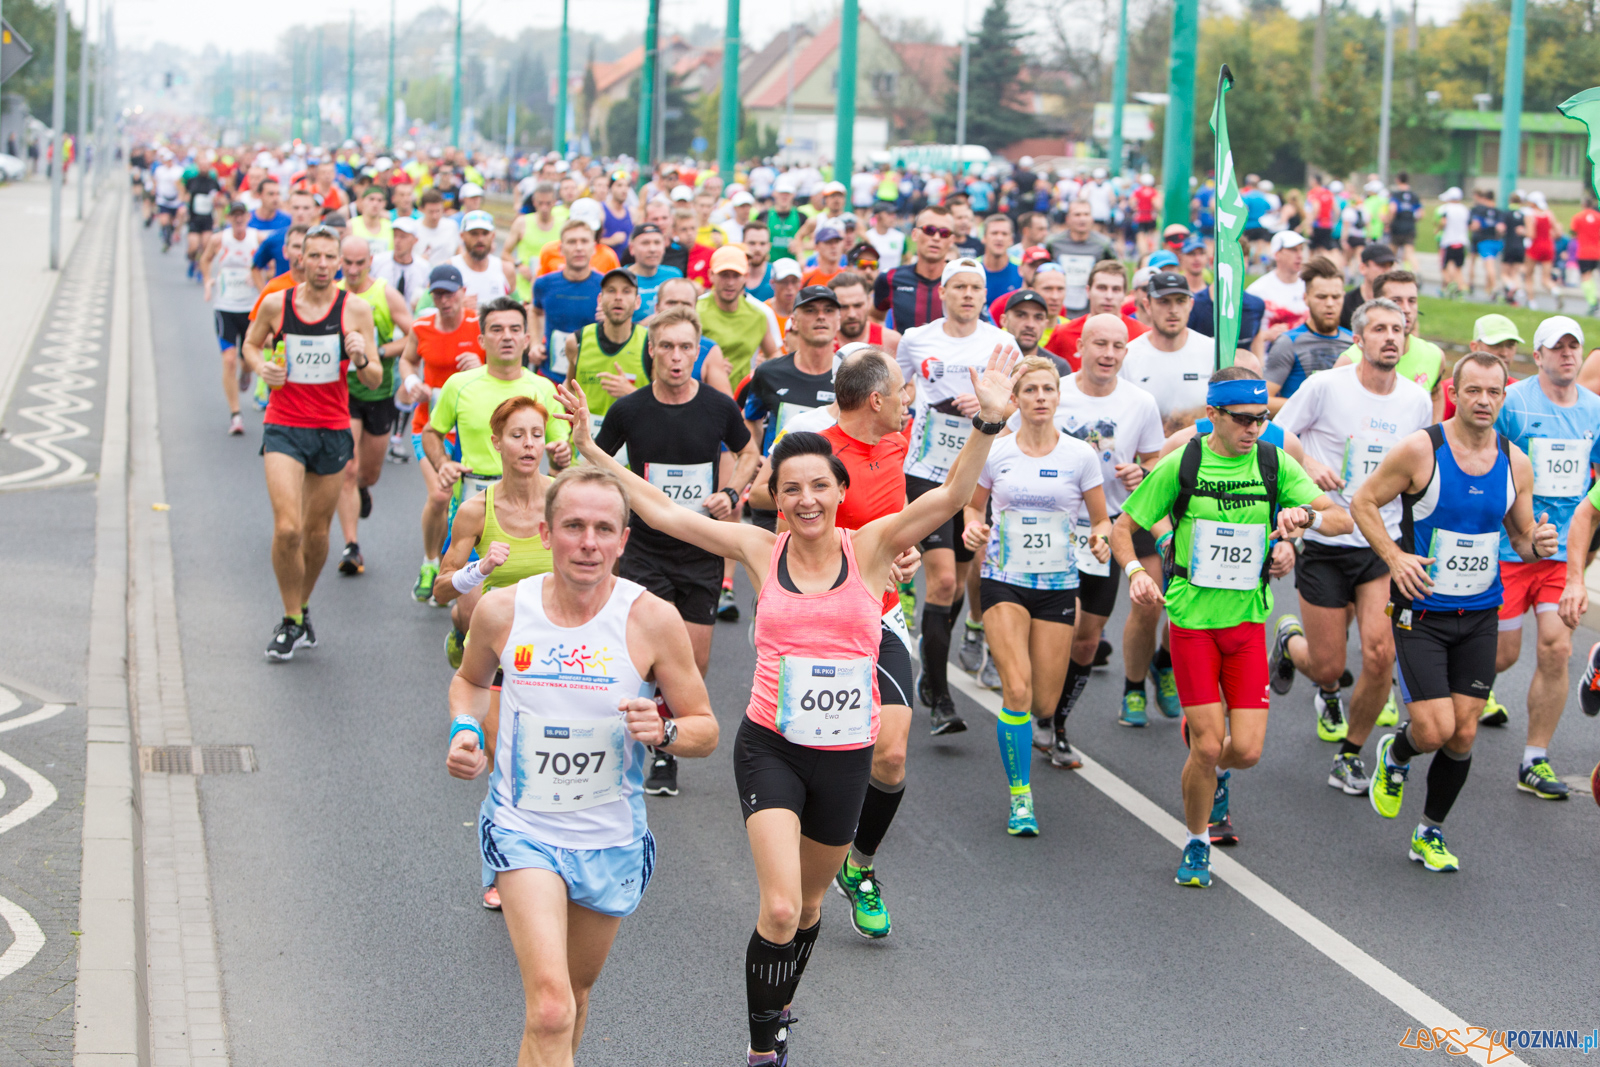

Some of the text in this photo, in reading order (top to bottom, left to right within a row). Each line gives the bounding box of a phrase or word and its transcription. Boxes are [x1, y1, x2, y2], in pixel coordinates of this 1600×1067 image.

[296, 352, 331, 365] 6720
[1370, 418, 1397, 434] bieg
[937, 432, 968, 450] 355
[1363, 460, 1380, 474] 17
[1546, 459, 1579, 473] 1601
[662, 485, 702, 500] 5762
[1014, 494, 1056, 503] ODWAGA
[1023, 533, 1051, 549] 231
[1210, 544, 1252, 564] 7182
[1446, 555, 1489, 572] 6328
[569, 683, 609, 691] DZIESIĄTKA
[800, 688, 861, 711] 6092
[824, 712, 840, 720] Ewa
[535, 750, 606, 776] 7097
[552, 776, 590, 786] Zbigniew
